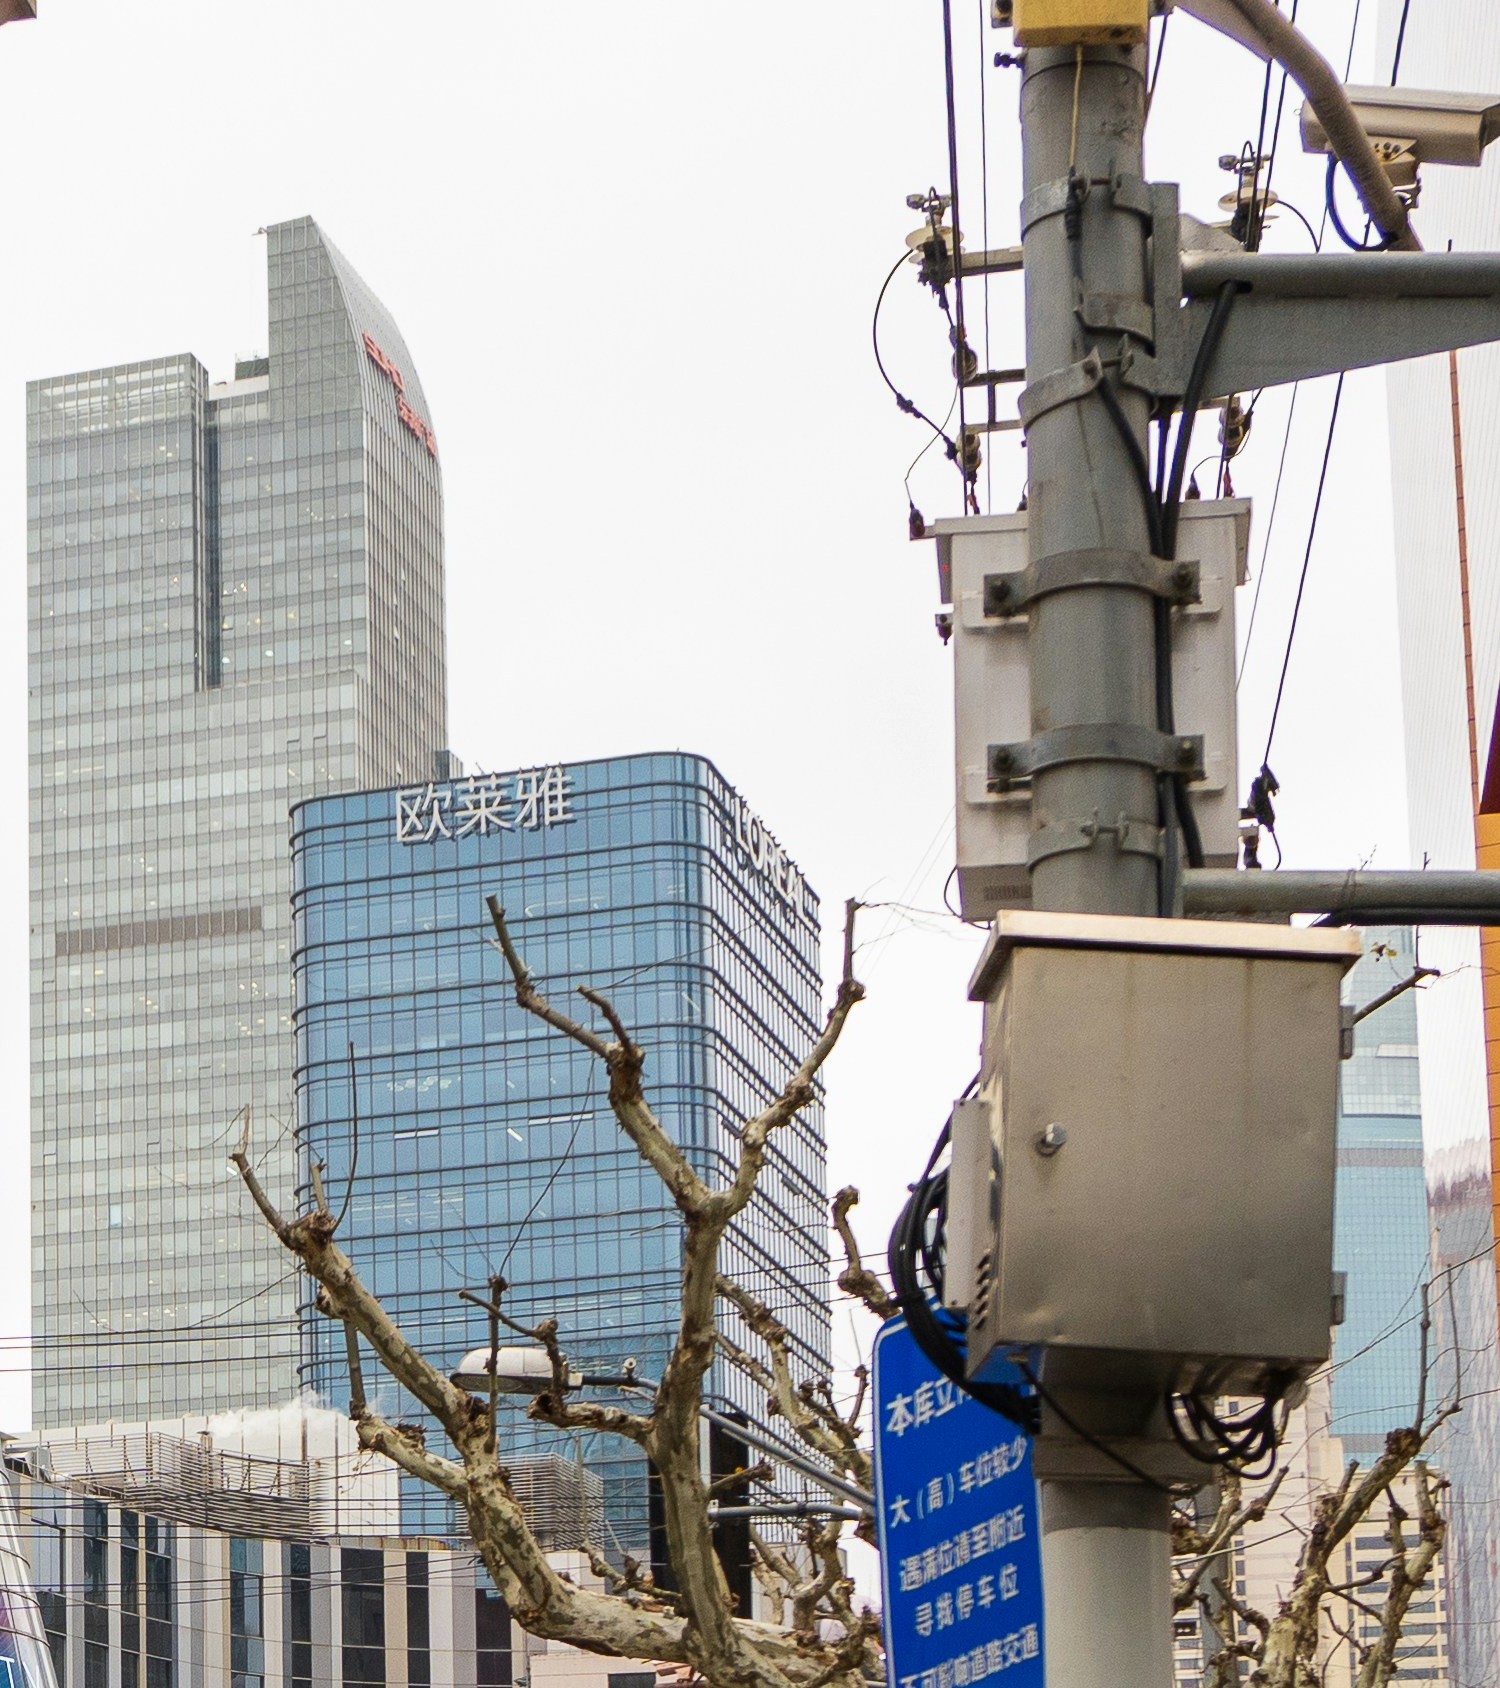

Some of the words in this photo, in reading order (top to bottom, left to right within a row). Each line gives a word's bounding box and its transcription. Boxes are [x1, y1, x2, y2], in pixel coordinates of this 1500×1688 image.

[395, 766, 574, 845] 欧莱雅
[914, 1563, 1020, 1639] 寻找停车位
